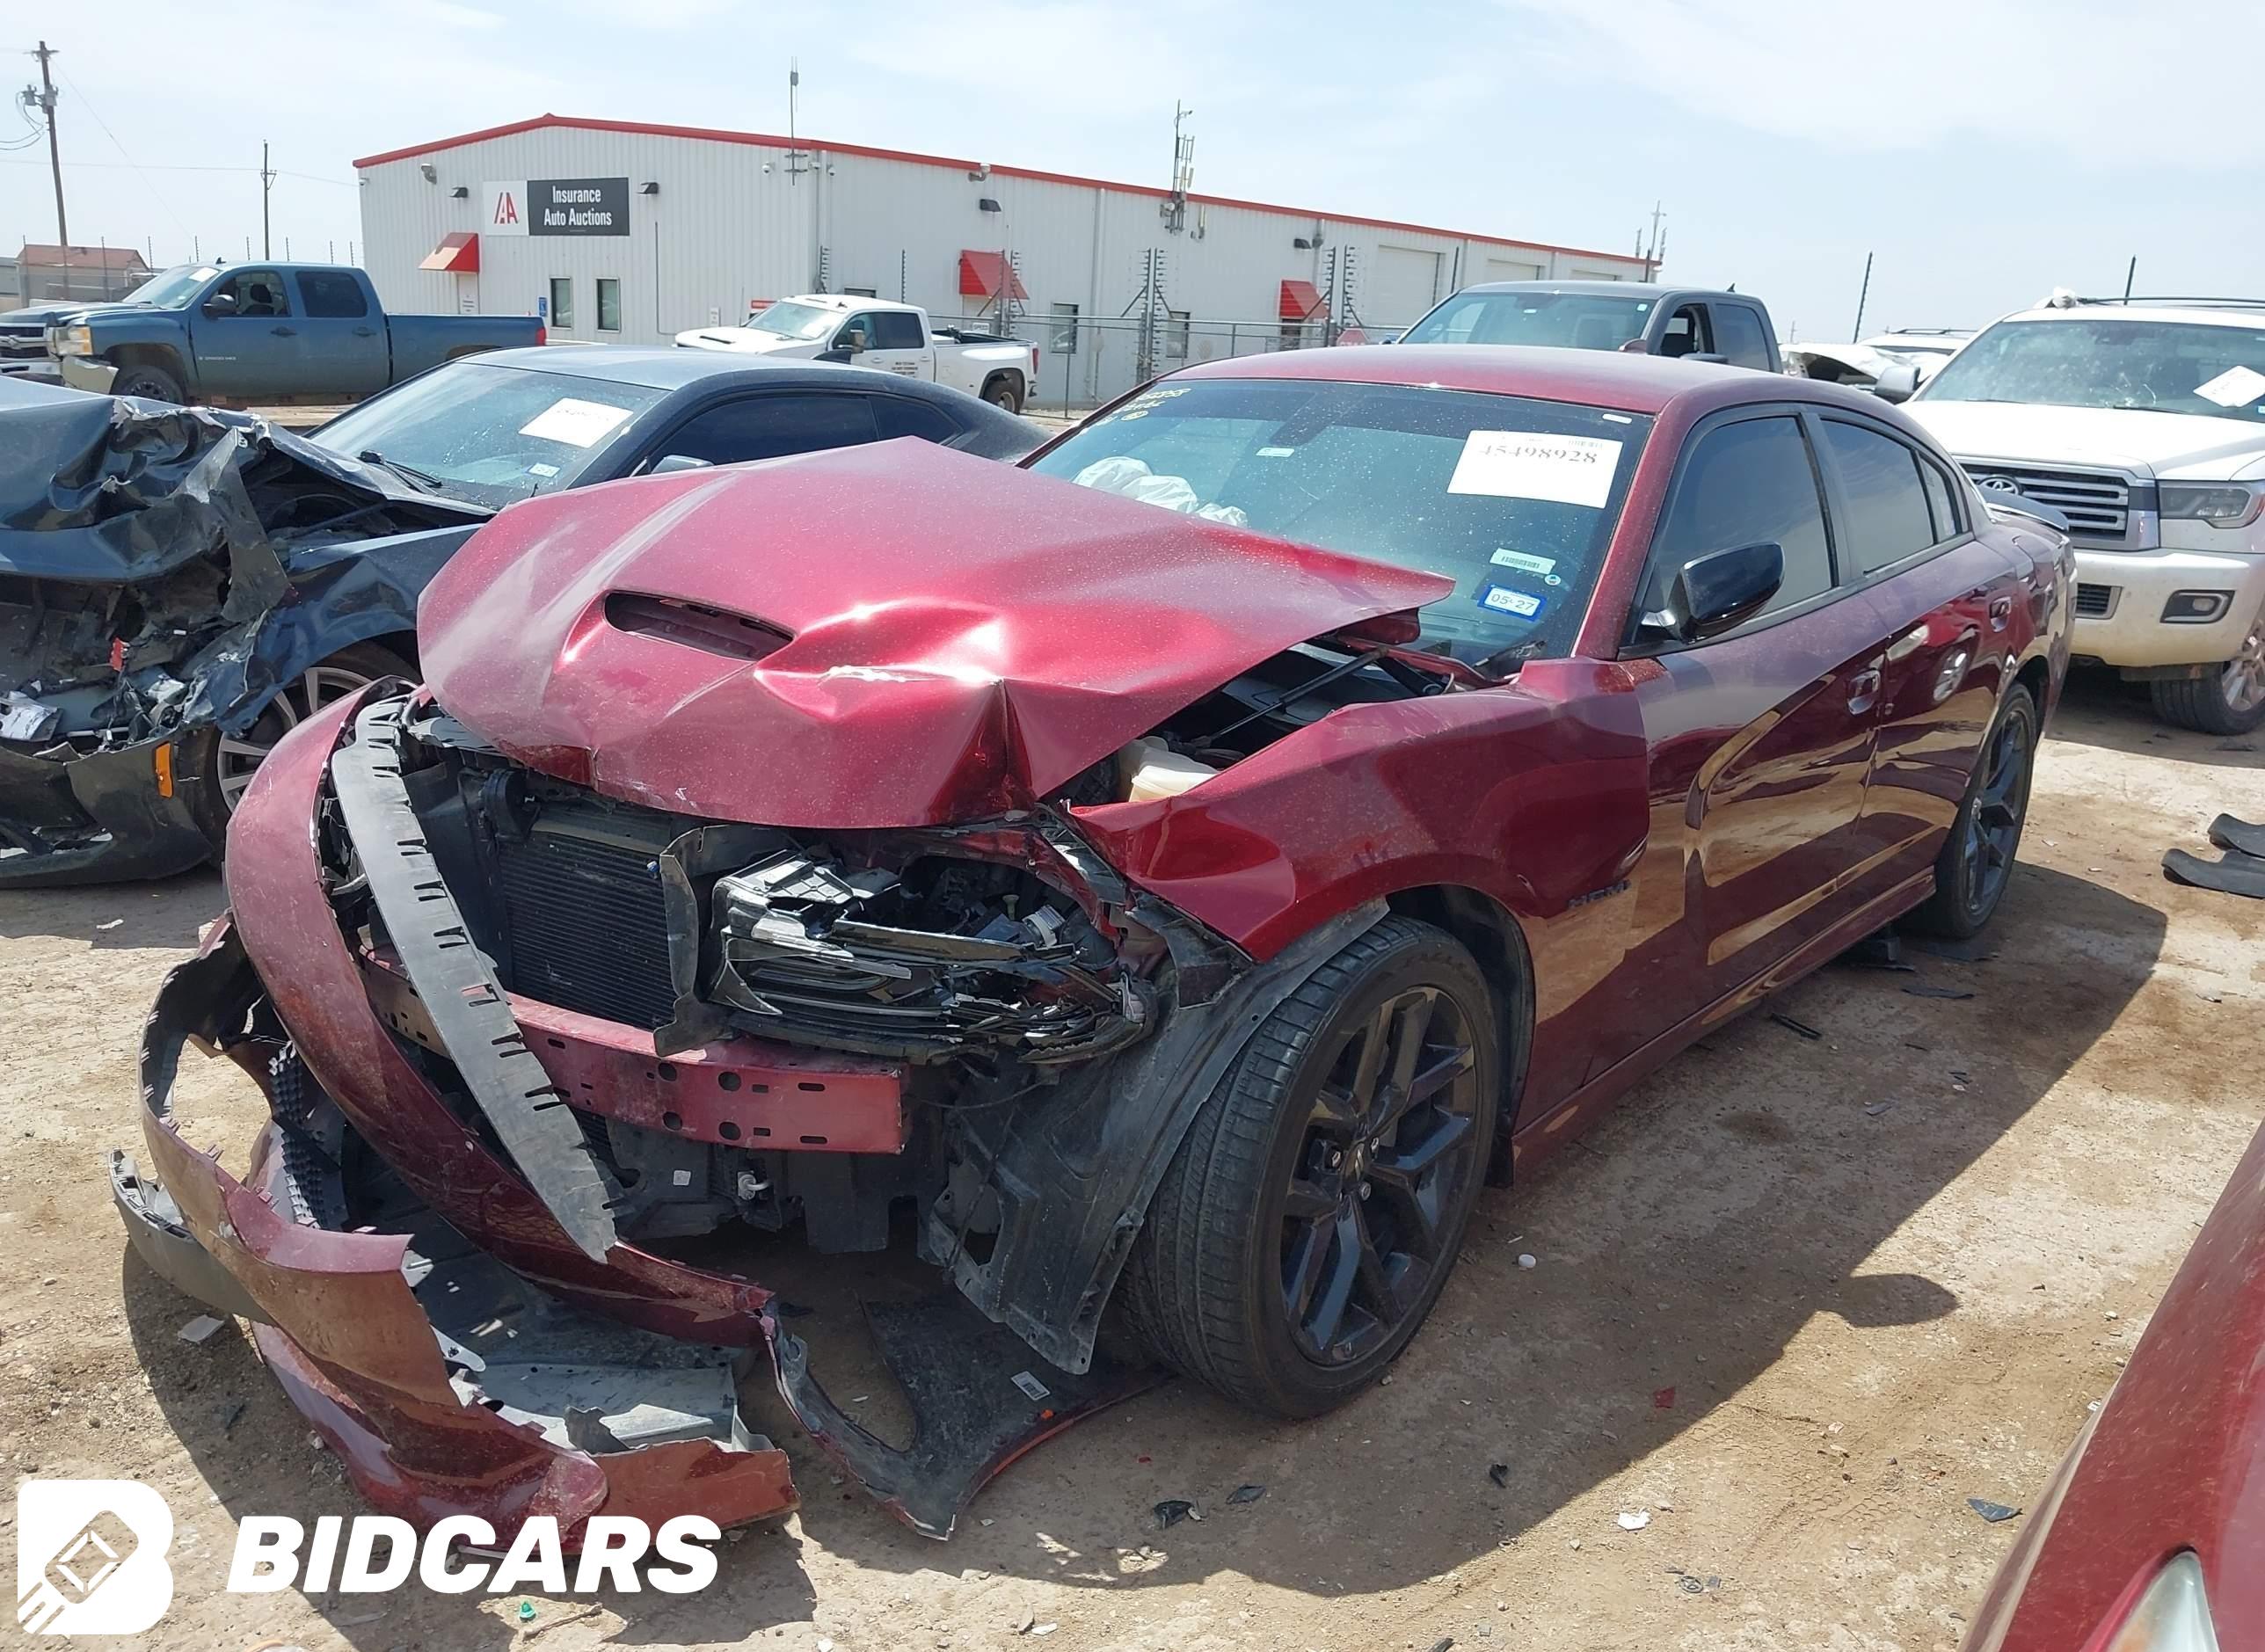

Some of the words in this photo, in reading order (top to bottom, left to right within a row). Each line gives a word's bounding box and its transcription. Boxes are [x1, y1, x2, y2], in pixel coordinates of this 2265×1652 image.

[552, 185, 601, 203] Insurance
[543, 207, 566, 226] Auto
[568, 207, 612, 226] Auctions
[1480, 445, 1598, 464] 45498928
[1491, 593, 1509, 605] 05
[1515, 600, 1534, 611] 27
